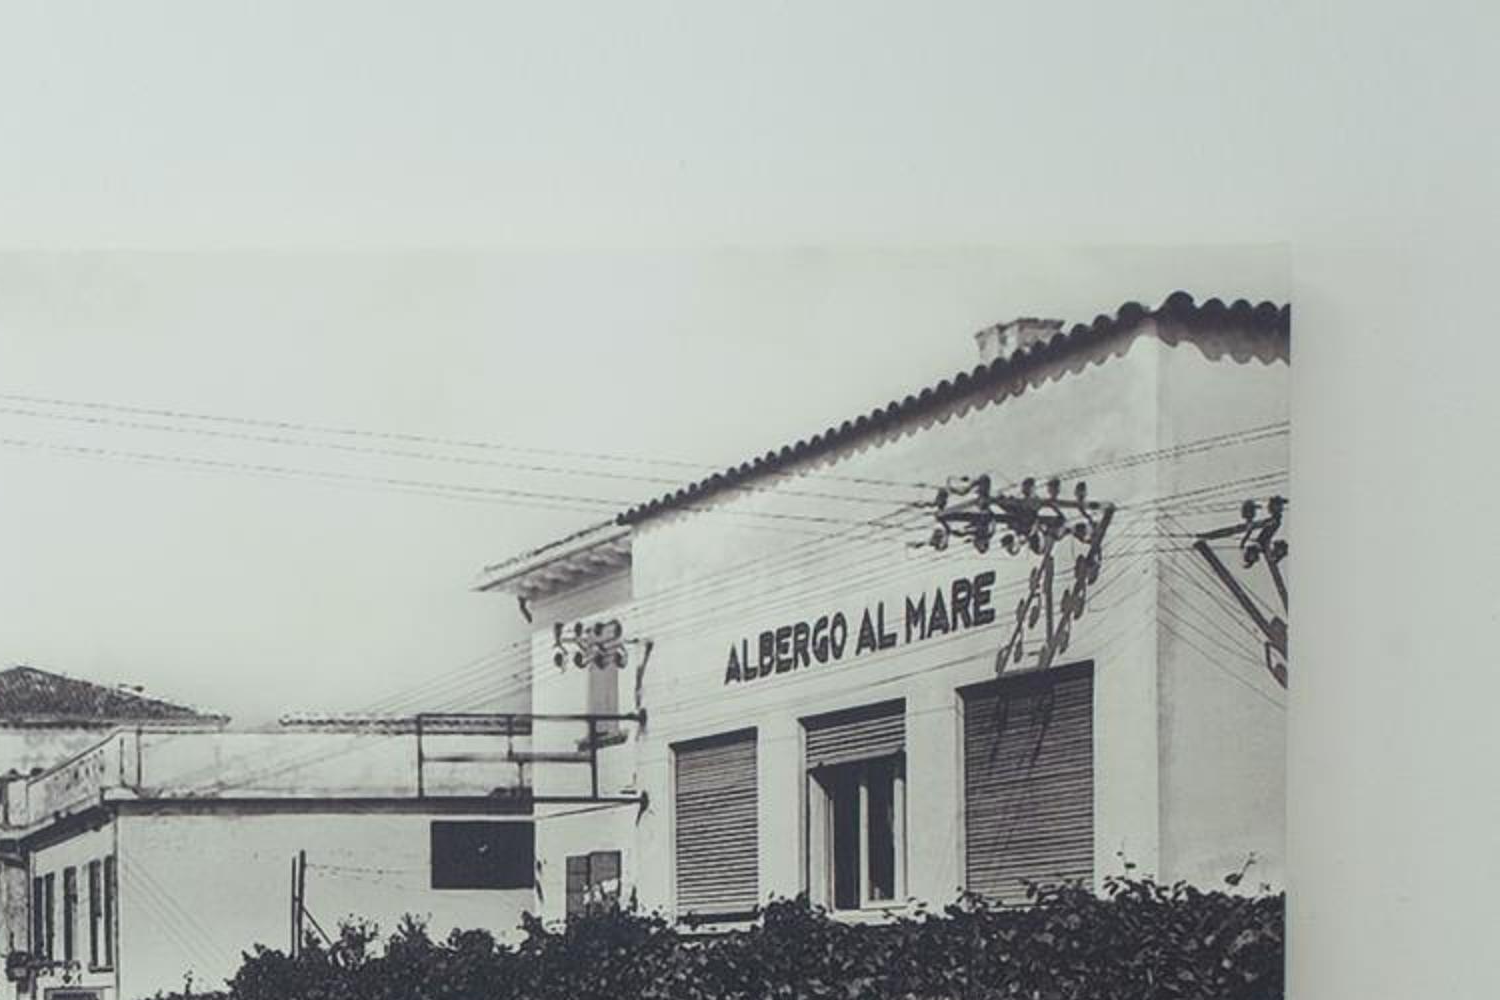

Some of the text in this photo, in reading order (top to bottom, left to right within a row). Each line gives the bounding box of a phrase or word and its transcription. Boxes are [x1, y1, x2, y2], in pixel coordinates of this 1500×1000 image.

[724, 570, 996, 685] ALBERGO AL MARE
